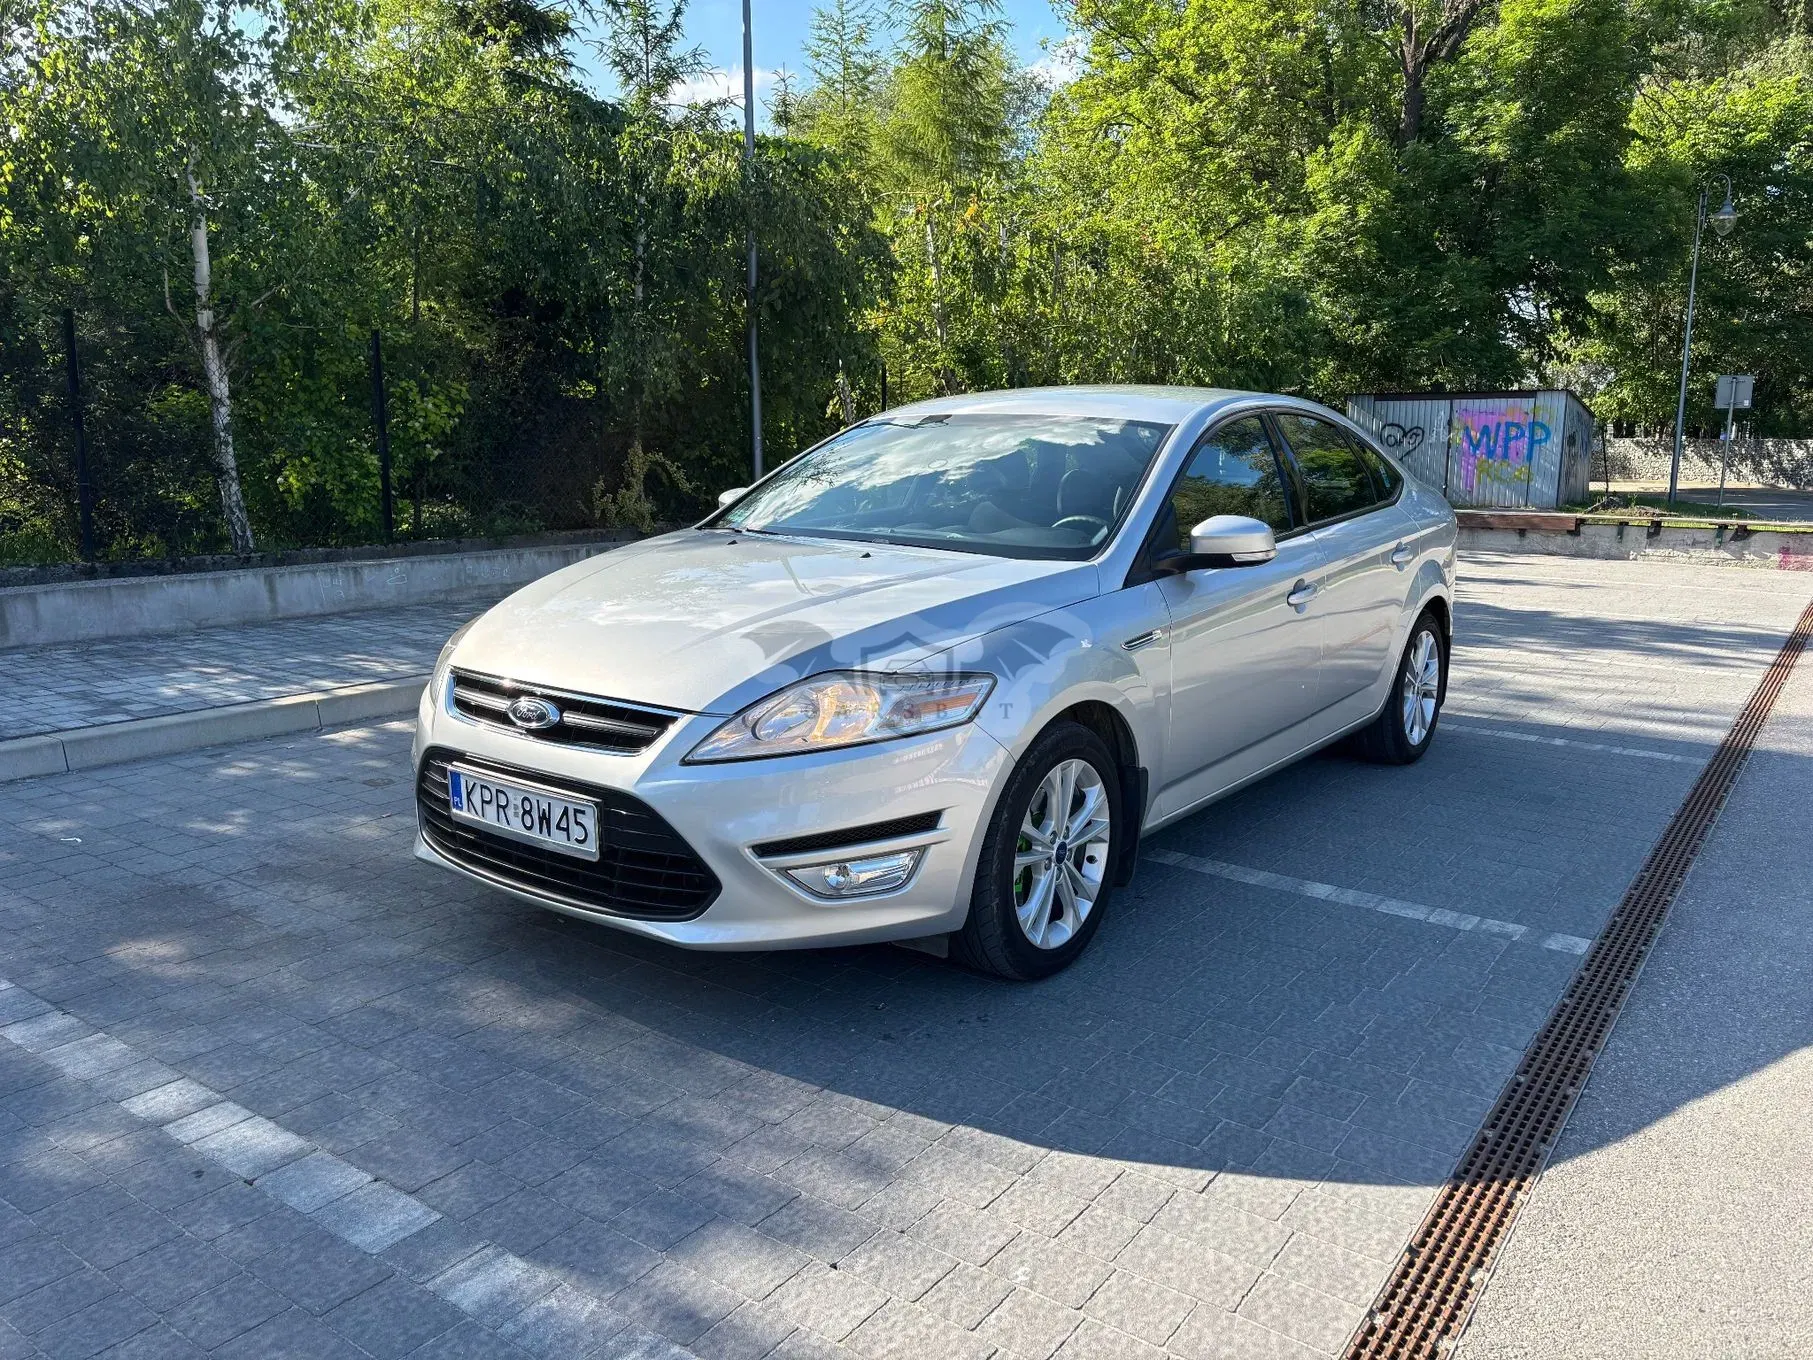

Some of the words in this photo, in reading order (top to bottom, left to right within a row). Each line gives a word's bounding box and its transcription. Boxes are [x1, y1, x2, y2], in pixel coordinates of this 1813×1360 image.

[1464, 420, 1551, 462] WPP
[516, 704, 541, 720] Ford
[465, 780, 510, 826] KPR
[521, 796, 588, 844] 8W45
